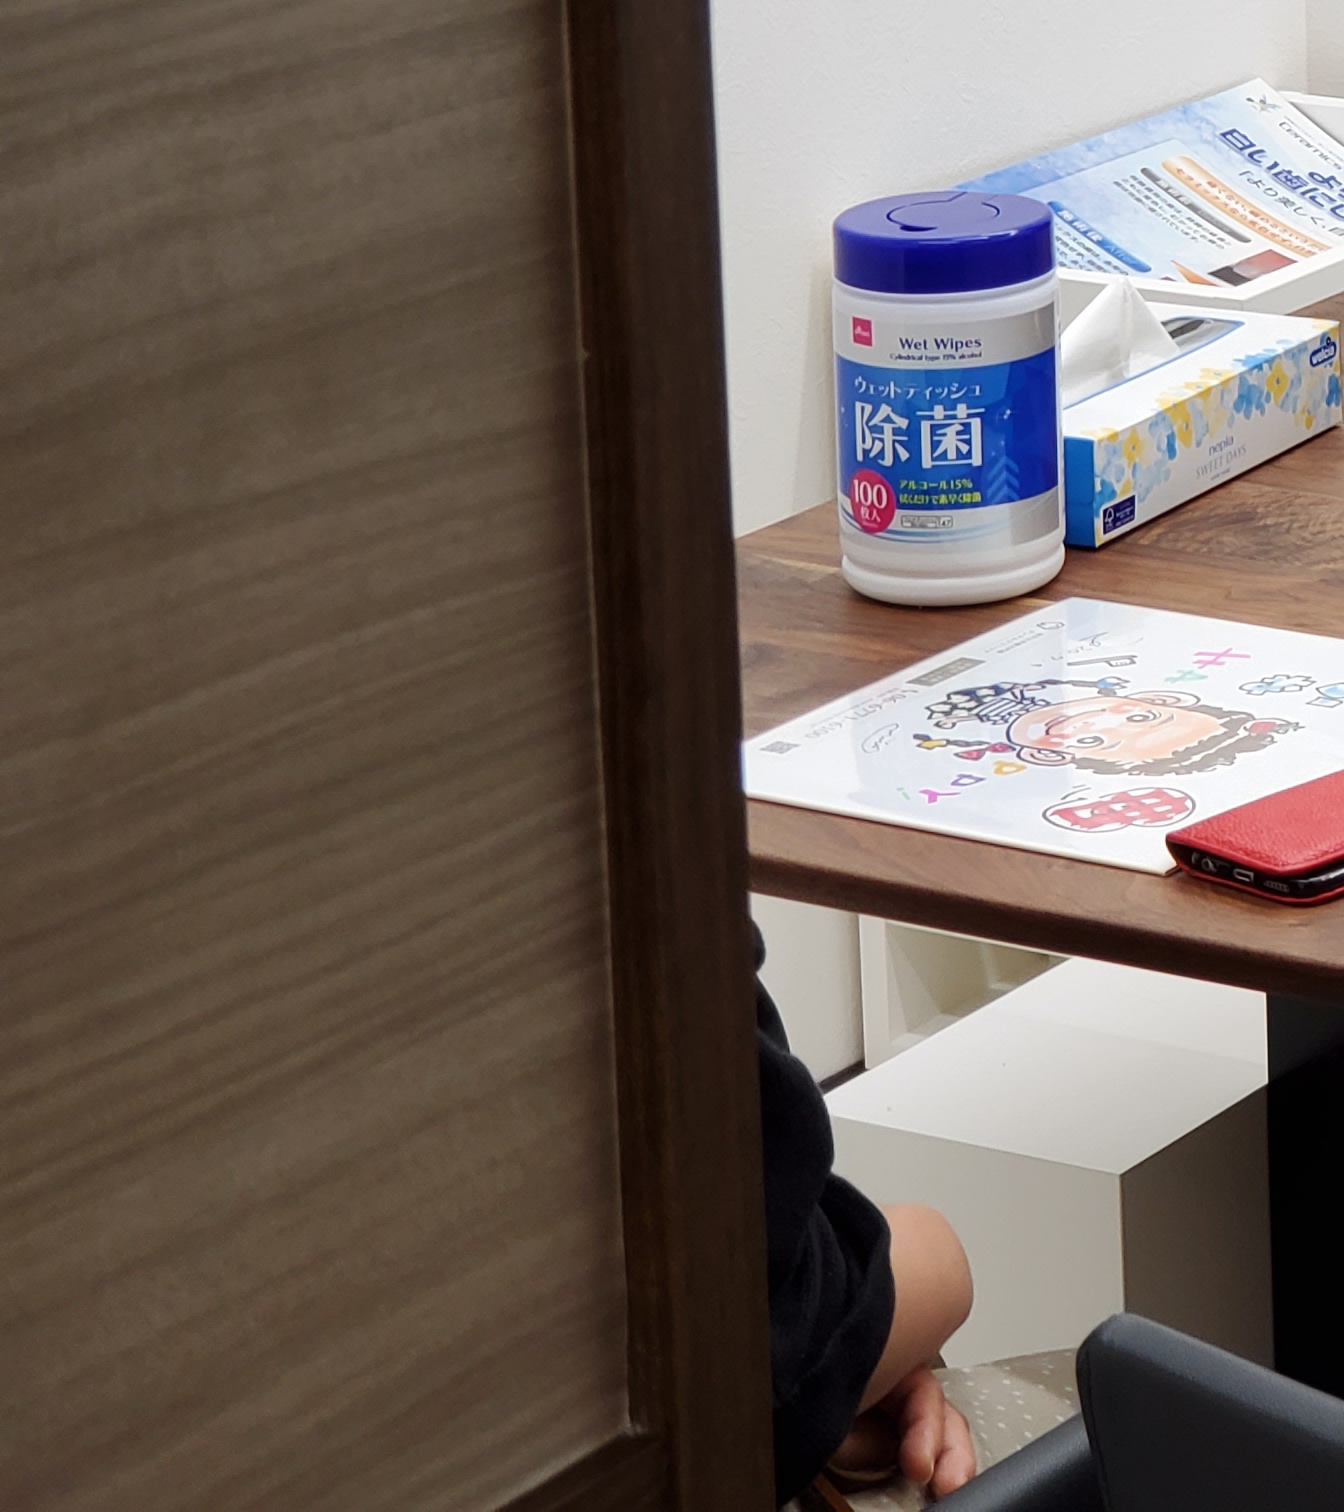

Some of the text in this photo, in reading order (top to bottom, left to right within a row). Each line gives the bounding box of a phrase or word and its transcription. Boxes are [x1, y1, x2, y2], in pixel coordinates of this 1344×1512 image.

[1279, 122, 1342, 170] Ceramics
[899, 337, 982, 352] Wet Wipes
[958, 351, 982, 360] alcohol
[854, 375, 981, 400] ウェットティッシュ
[855, 400, 985, 469] 除菌
[1209, 434, 1234, 457] nepia
[853, 479, 888, 509] 100
[899, 478, 973, 490] アルコール15%
